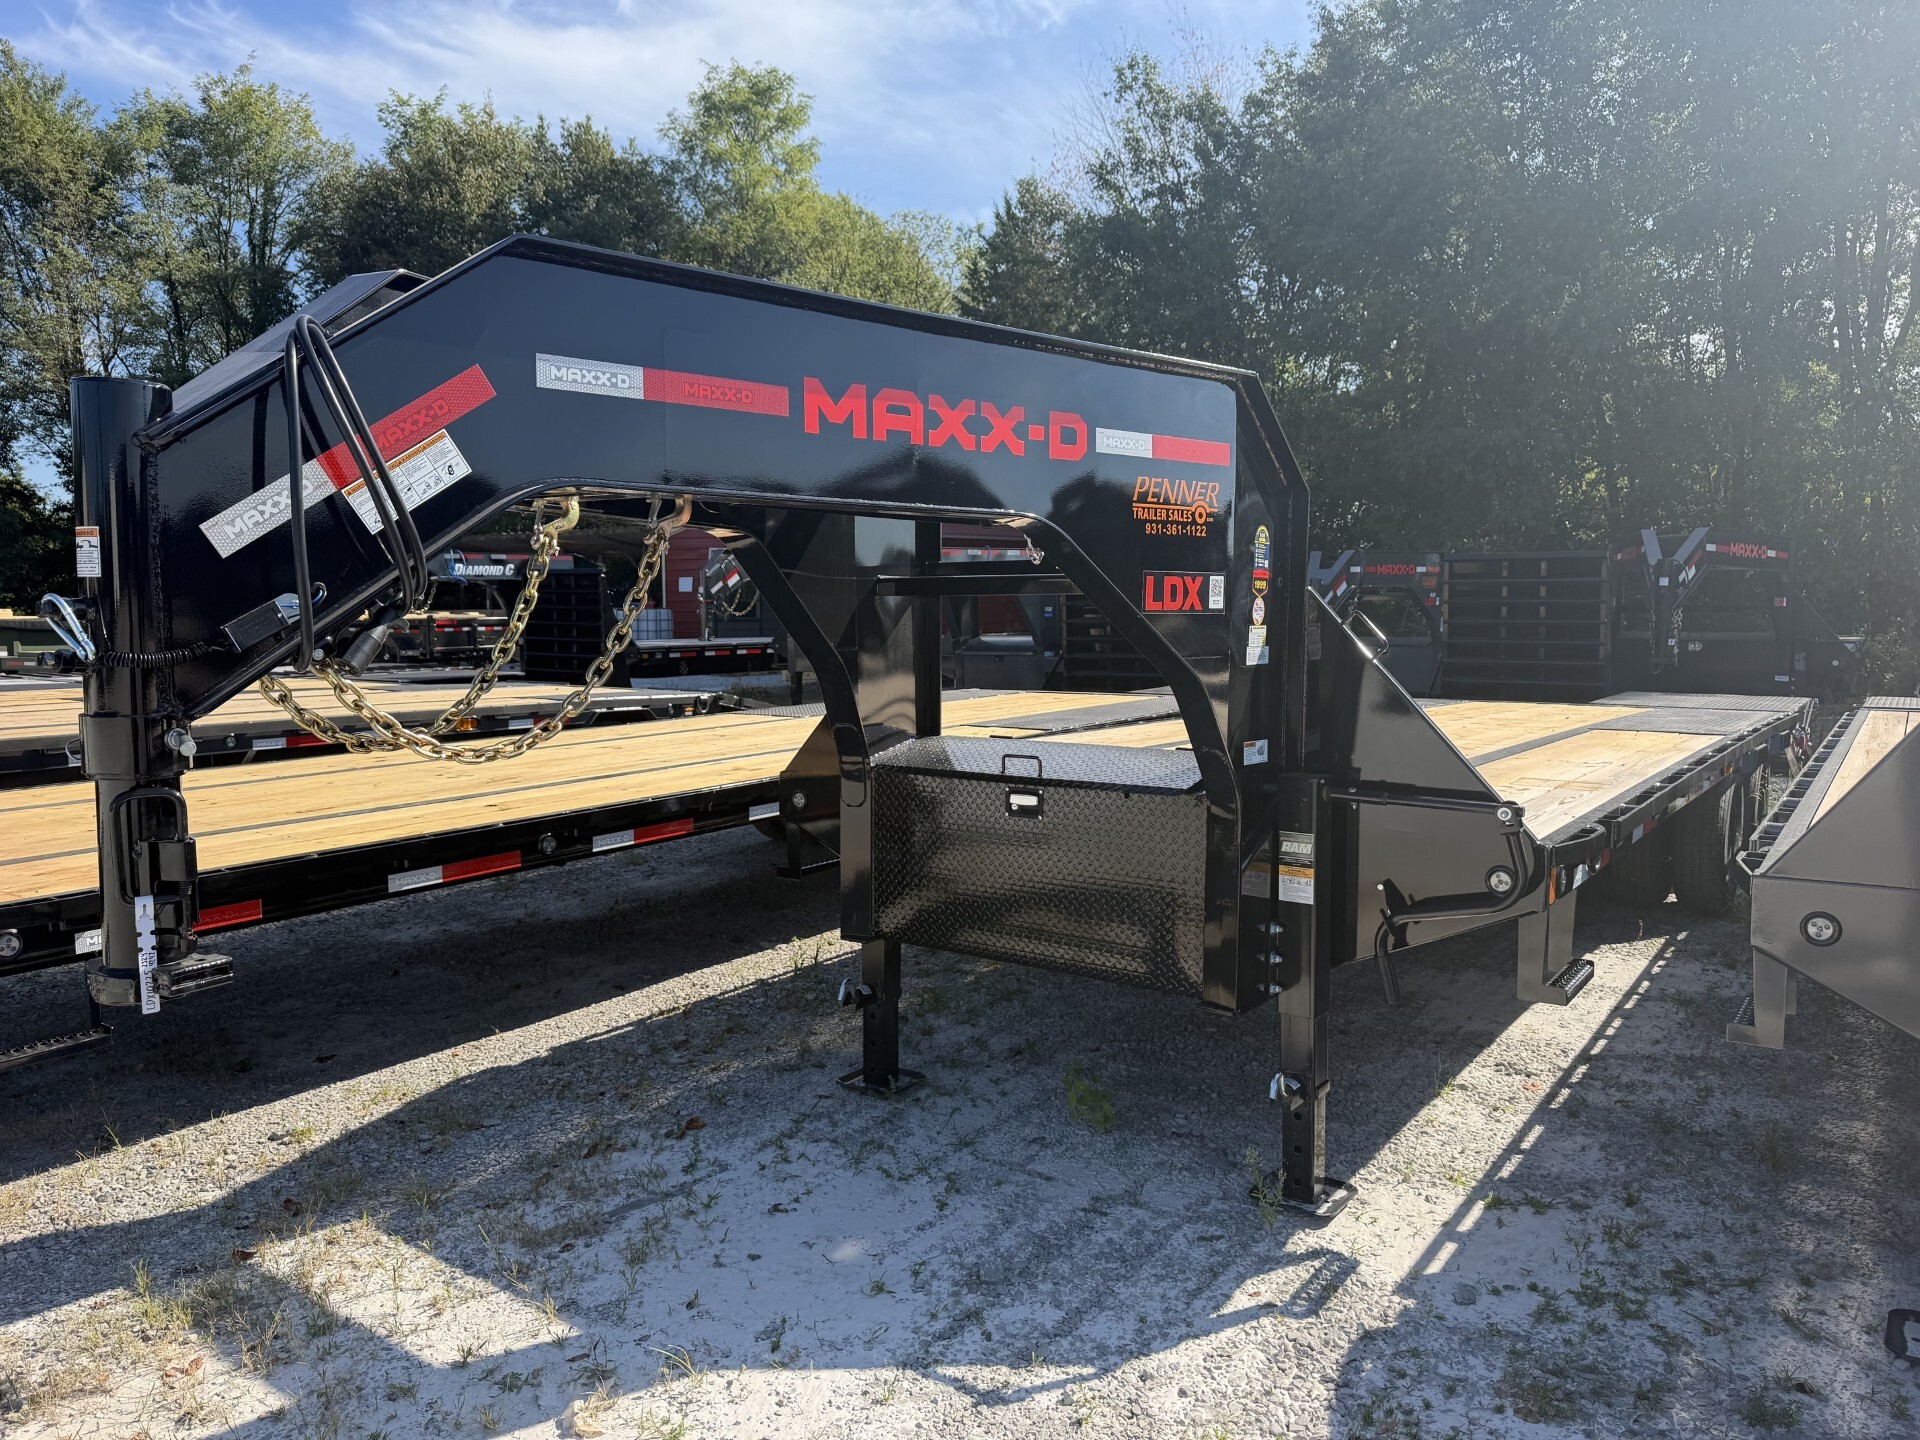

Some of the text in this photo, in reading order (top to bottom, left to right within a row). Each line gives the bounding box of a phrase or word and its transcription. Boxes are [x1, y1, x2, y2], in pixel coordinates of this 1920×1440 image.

[549, 365, 630, 389] MAXX-D
[684, 382, 753, 404] MAXX-D
[803, 376, 1088, 462] MAXX-D
[1103, 436, 1145, 451] MAXX-D
[1132, 476, 1220, 507] PENNER
[223, 478, 315, 541] MAXXD
[1132, 507, 1167, 521] TRAILER
[1168, 510, 1193, 522] SALES
[1145, 523, 1207, 537] 931-361-1122
[1730, 542, 1767, 559] MAXX-D
[453, 563, 515, 576] DIAMOND C
[1377, 564, 1415, 575] MAXX-D
[1145, 575, 1204, 611] LDX
[598, 834, 629, 847] MAXX-D
[1281, 841, 1313, 855] RAM
[395, 872, 436, 886] MAXX-D
